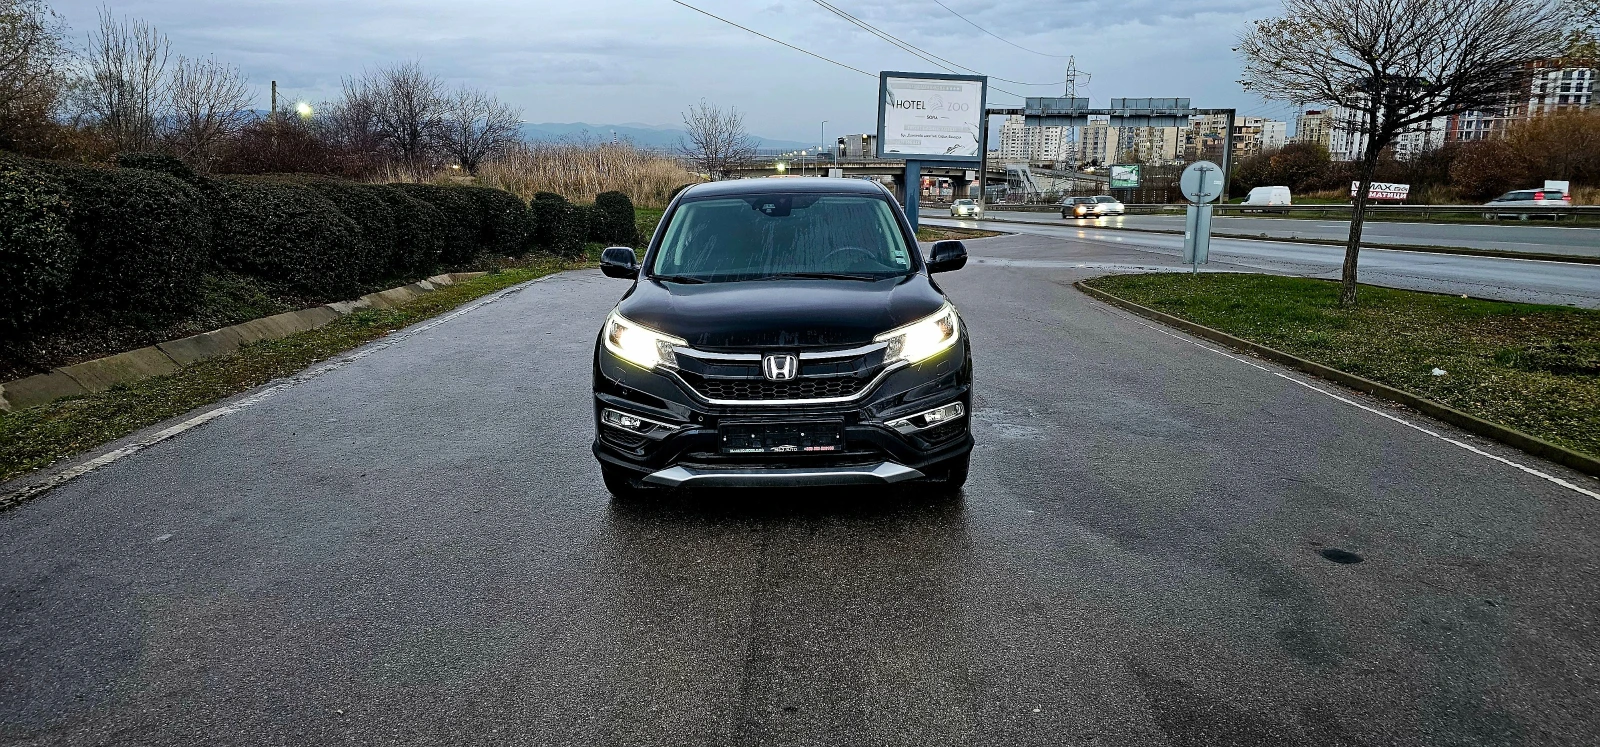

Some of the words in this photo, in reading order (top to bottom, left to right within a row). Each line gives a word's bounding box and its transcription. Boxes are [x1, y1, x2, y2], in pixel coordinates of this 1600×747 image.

[896, 100, 926, 110] HOTEL
[947, 102, 970, 112] ZOO
[1351, 190, 1407, 199] КМАТИЦИ
